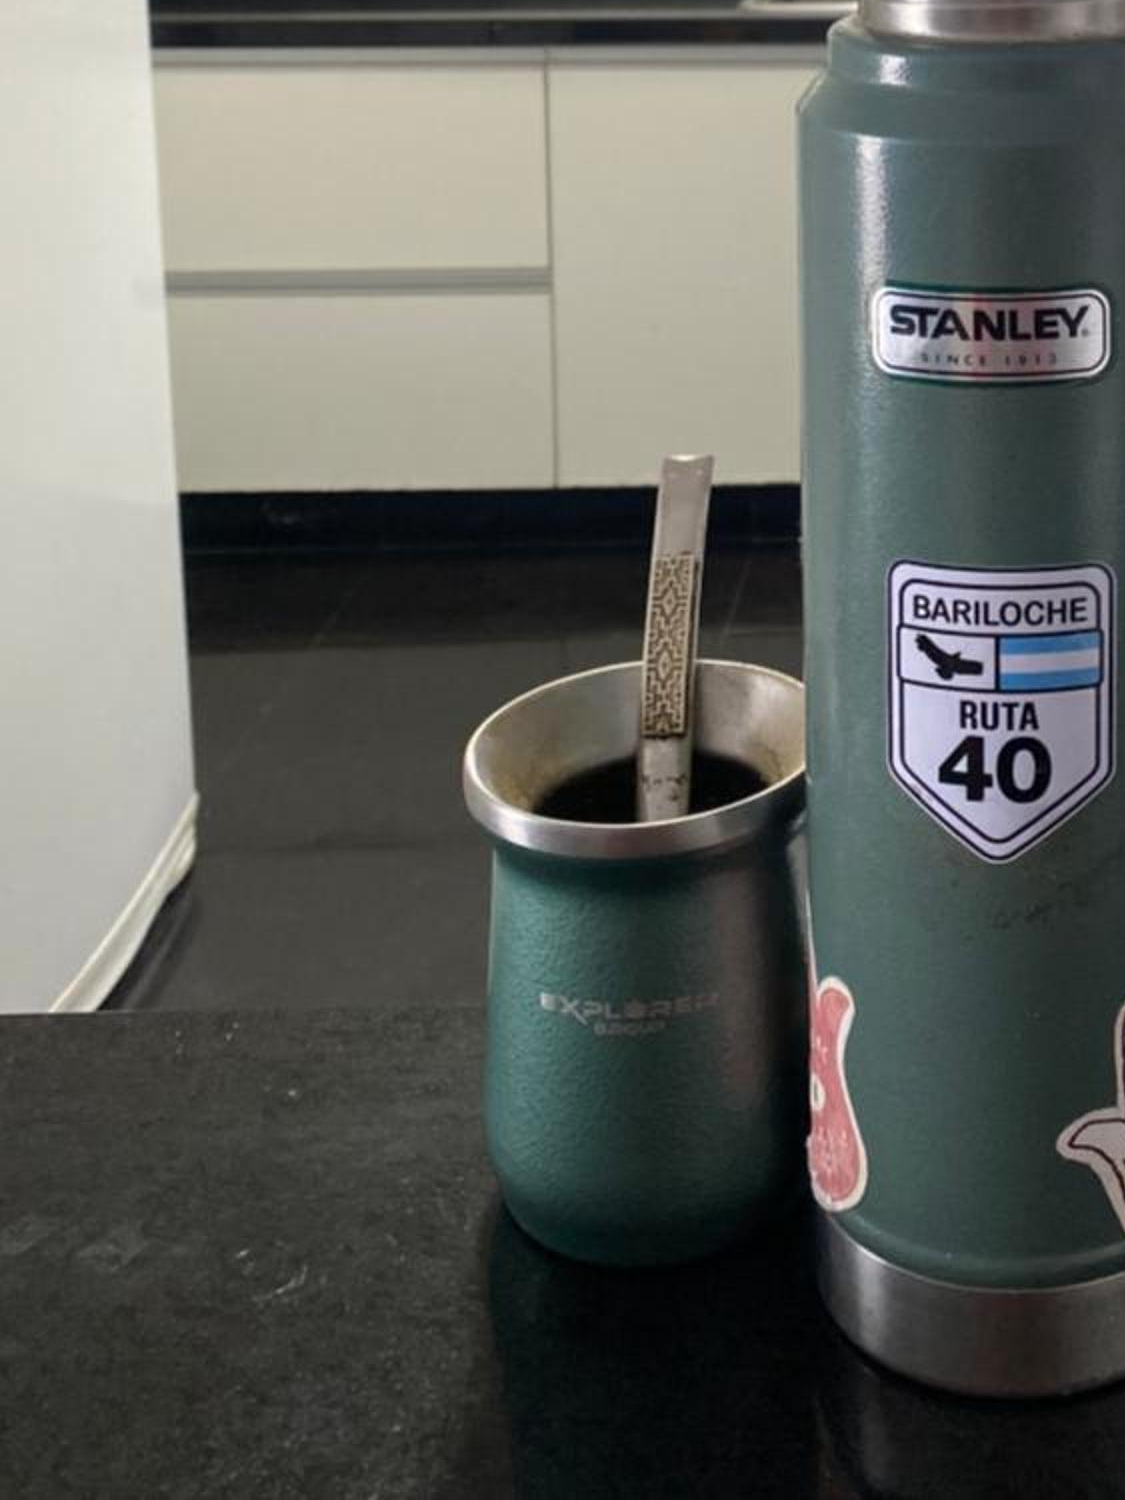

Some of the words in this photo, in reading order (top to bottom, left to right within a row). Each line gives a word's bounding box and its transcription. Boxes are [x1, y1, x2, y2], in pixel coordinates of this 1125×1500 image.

[889, 304, 1089, 341] STANLEY
[920, 352, 987, 368] SINCE
[912, 594, 1089, 627] BARILOCHE
[959, 700, 1039, 731] RUTA
[937, 735, 1053, 804] 40
